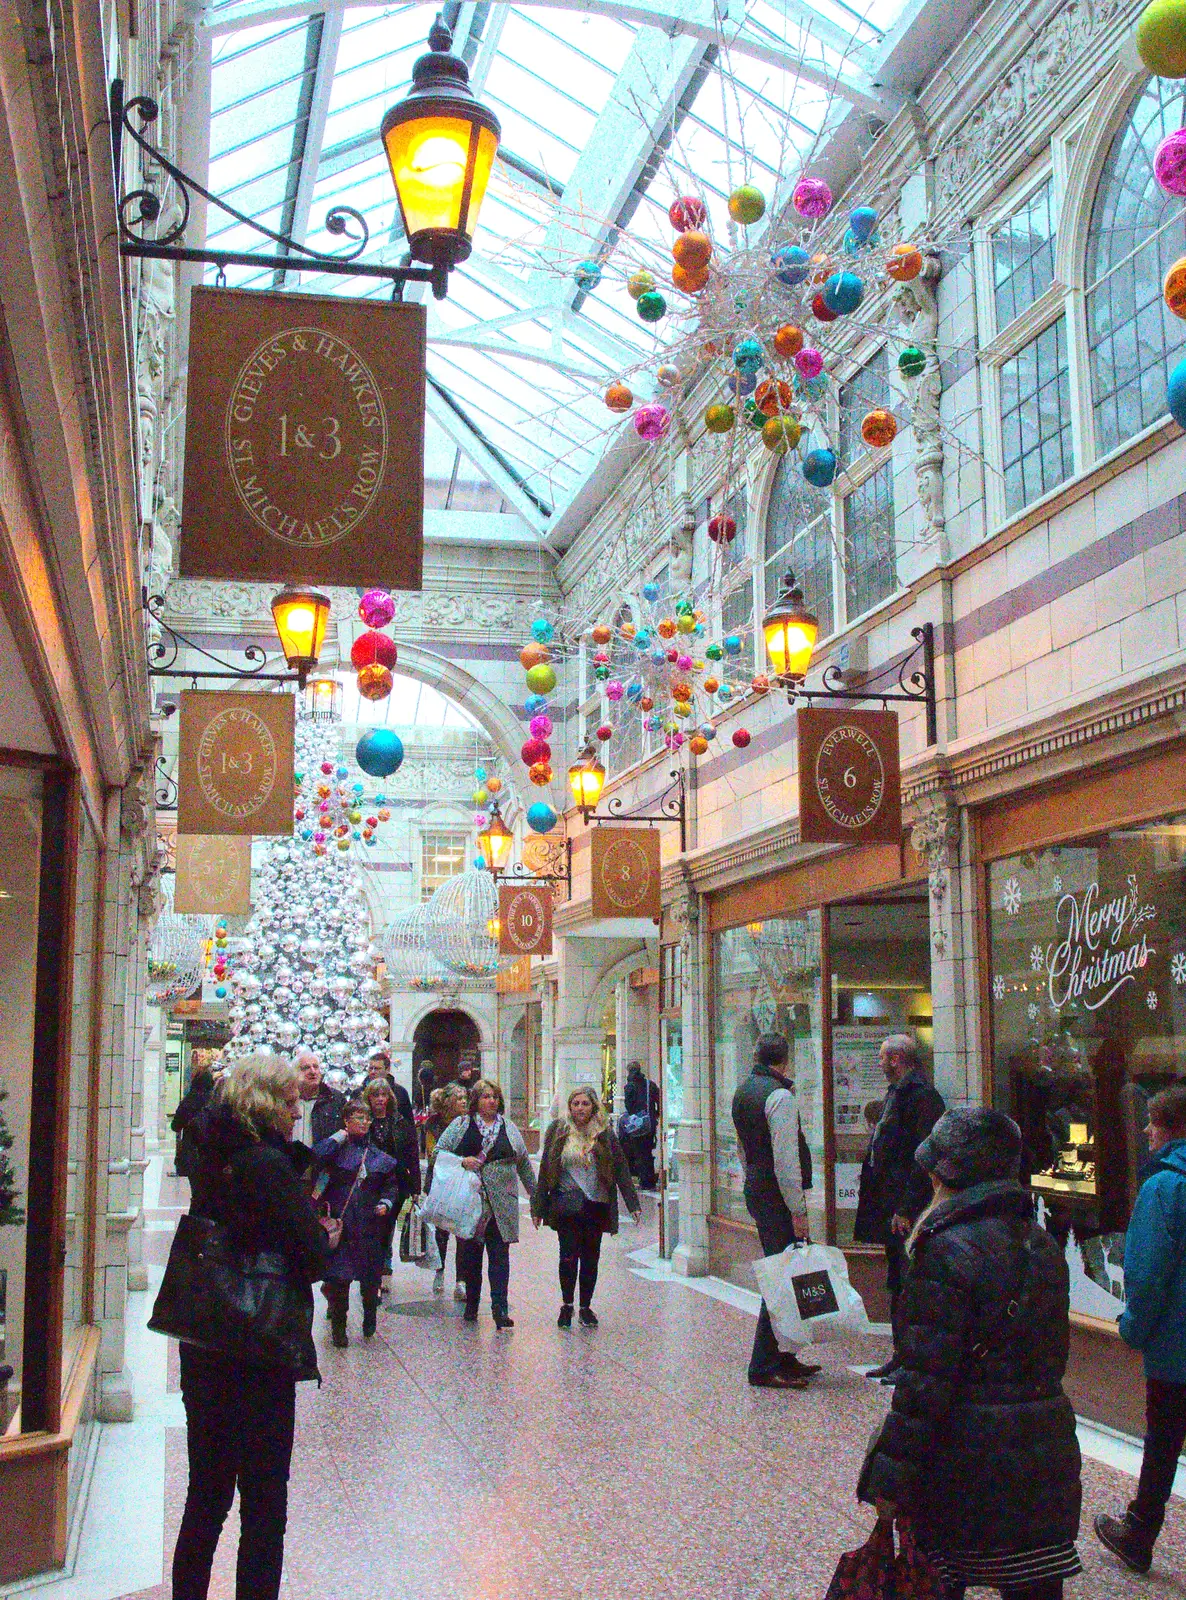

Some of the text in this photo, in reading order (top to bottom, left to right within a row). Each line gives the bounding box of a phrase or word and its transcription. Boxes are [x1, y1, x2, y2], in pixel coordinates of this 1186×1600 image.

[234, 335, 381, 428] GIEVES & HAWKES
[351, 444, 380, 500] ROW
[201, 716, 228, 757] GIEVES
[240, 711, 273, 757] HAWKES
[822, 729, 876, 758] EVERWELL
[258, 766, 273, 794] ROW
[843, 766, 857, 788] 6
[869, 779, 882, 805] ROW
[621, 865, 631, 881] 8
[521, 914, 533, 927] 10
[1057, 882, 1130, 956] Merry
[509, 965, 519, 974] 14
[1046, 933, 1156, 1008] Christmas
[838, 1188, 856, 1198] EAR
[801, 1284, 826, 1299] M&S
